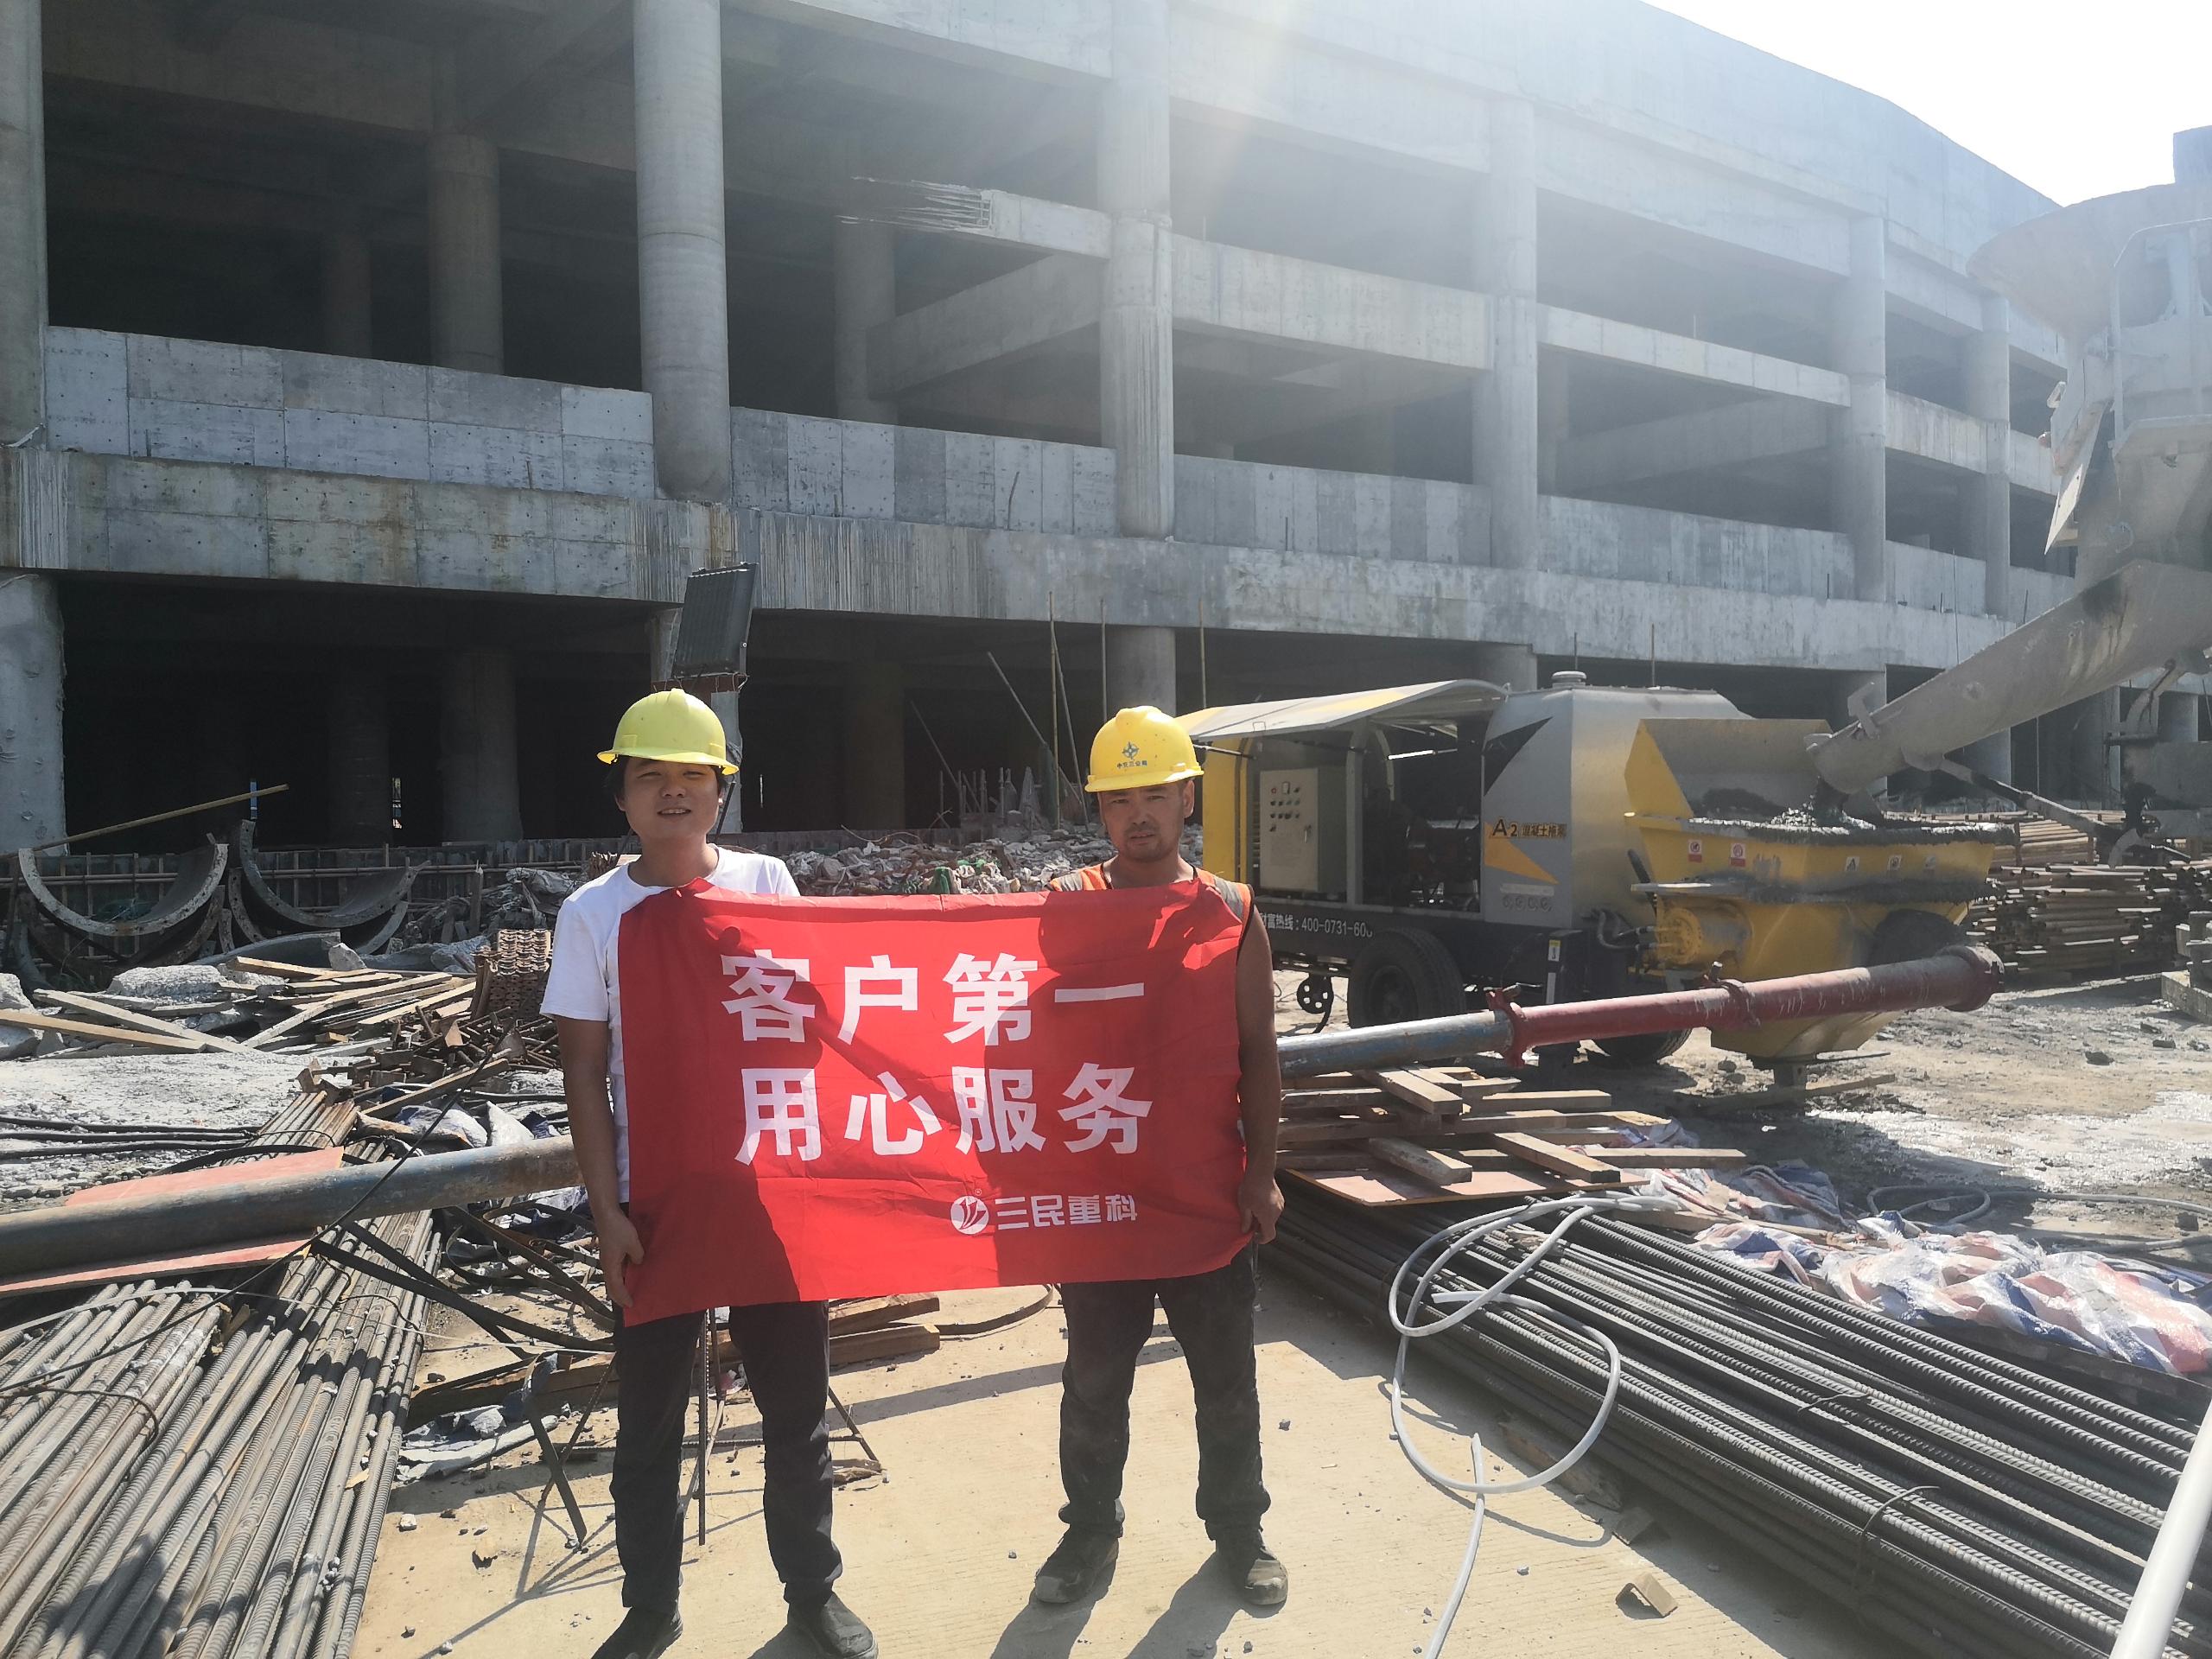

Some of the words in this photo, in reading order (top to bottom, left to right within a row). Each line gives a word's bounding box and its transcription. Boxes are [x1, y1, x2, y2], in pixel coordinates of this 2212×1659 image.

[1492, 818, 1518, 836] A2
[721, 949, 1146, 1046] 客户第一
[734, 1063, 1154, 1166] 用心服务
[995, 1194, 1138, 1230] 三民重科
